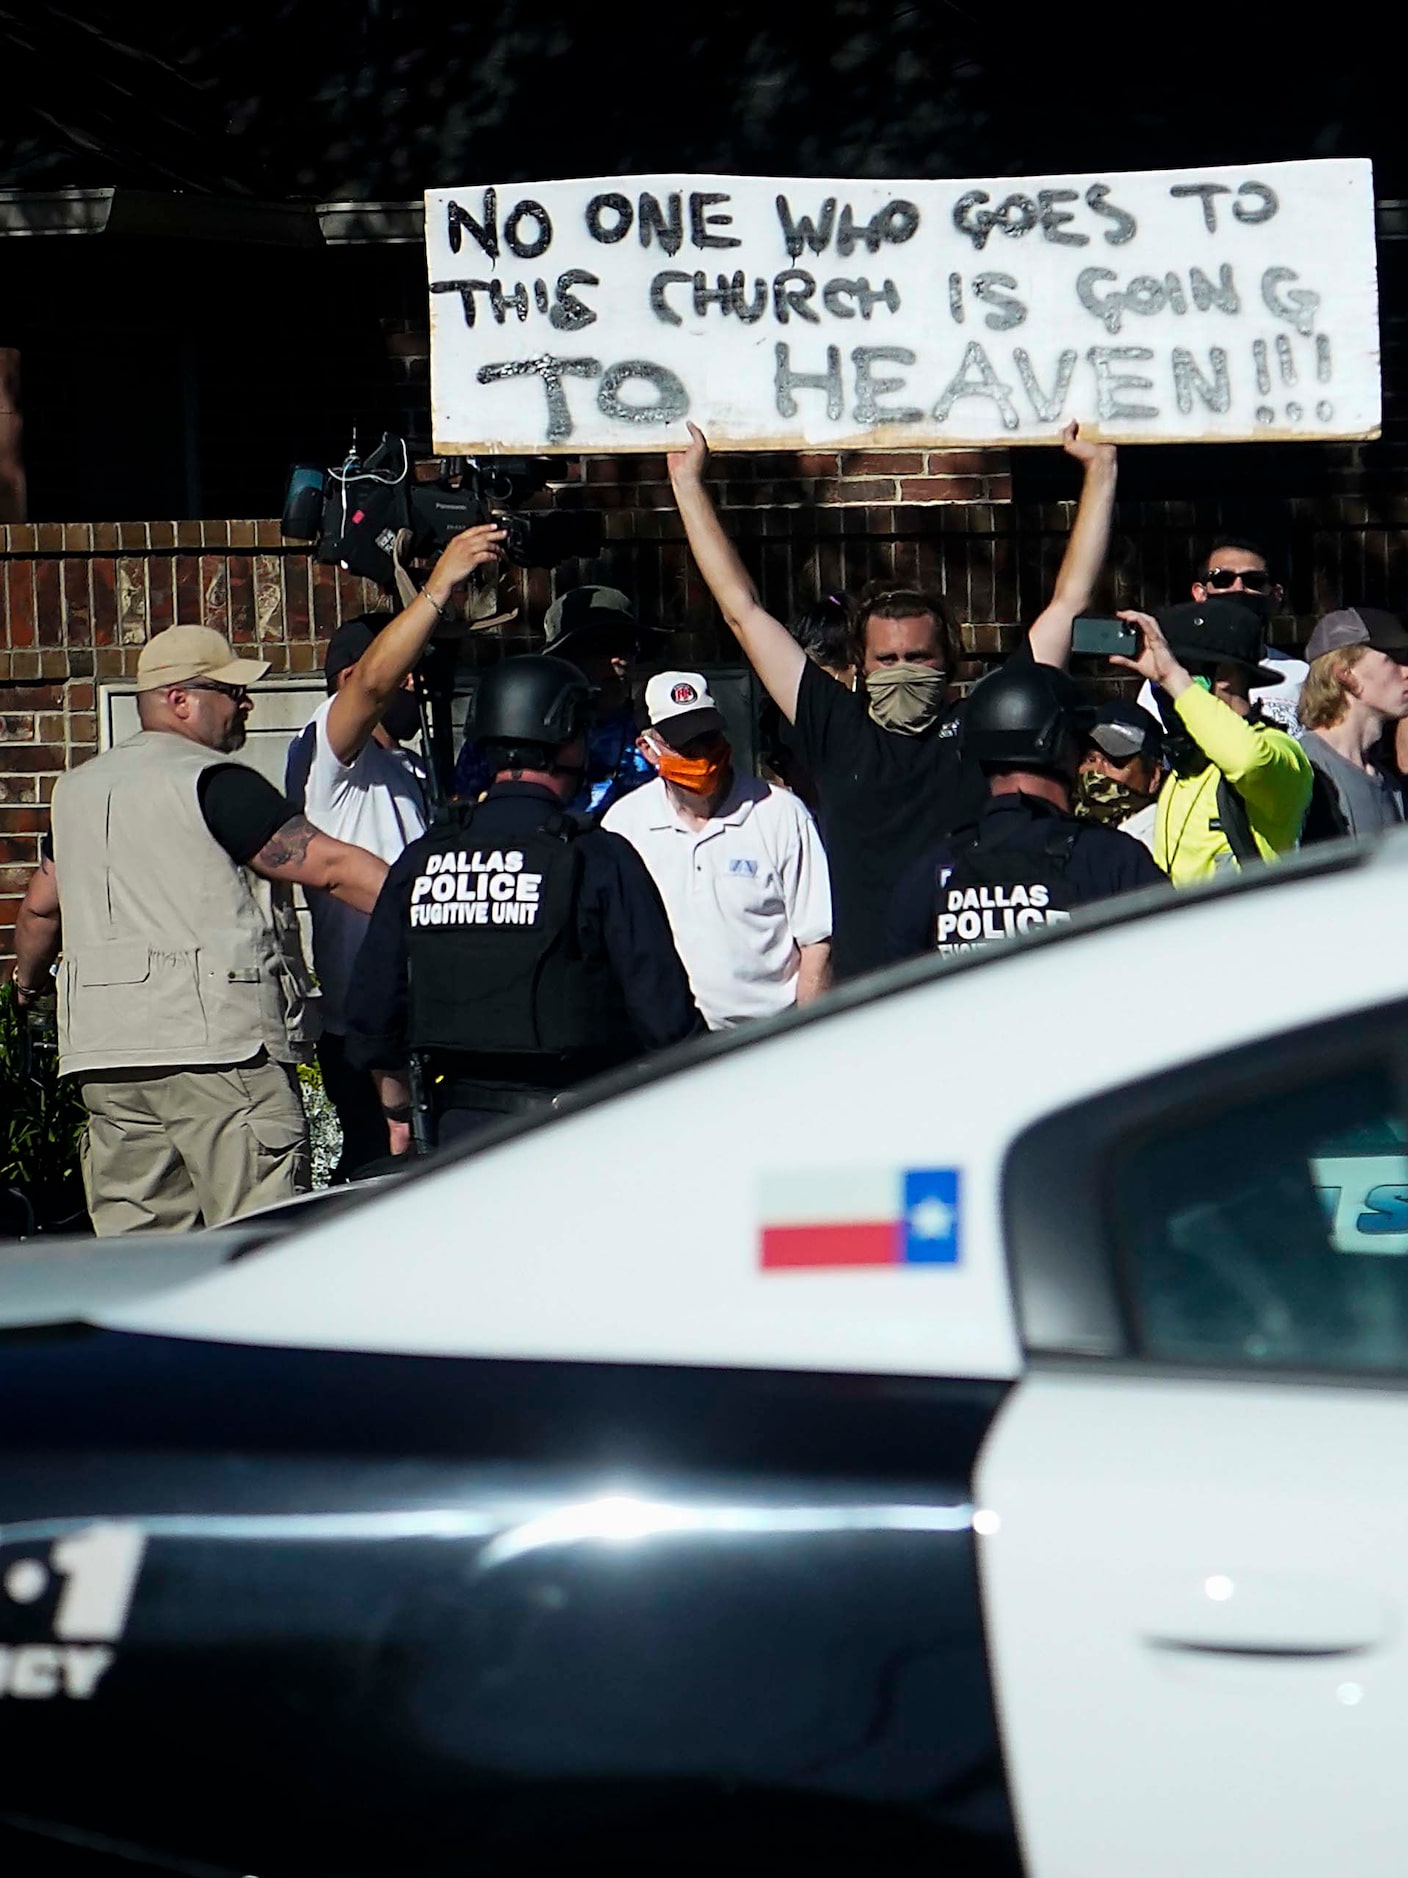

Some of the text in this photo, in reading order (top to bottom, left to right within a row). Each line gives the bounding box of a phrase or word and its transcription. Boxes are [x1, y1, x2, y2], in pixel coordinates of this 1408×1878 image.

[448, 180, 1279, 262] NO ONE WHO GOES TO
[430, 262, 1321, 336] THIS CHURCH IS GOING
[477, 334, 1332, 443] TO HEAVEN!!!
[425, 850, 524, 875] DALLAS
[411, 873, 542, 904] POLICE
[948, 884, 1050, 911] DALLAS
[410, 902, 538, 927] FUGITIVE UNIT
